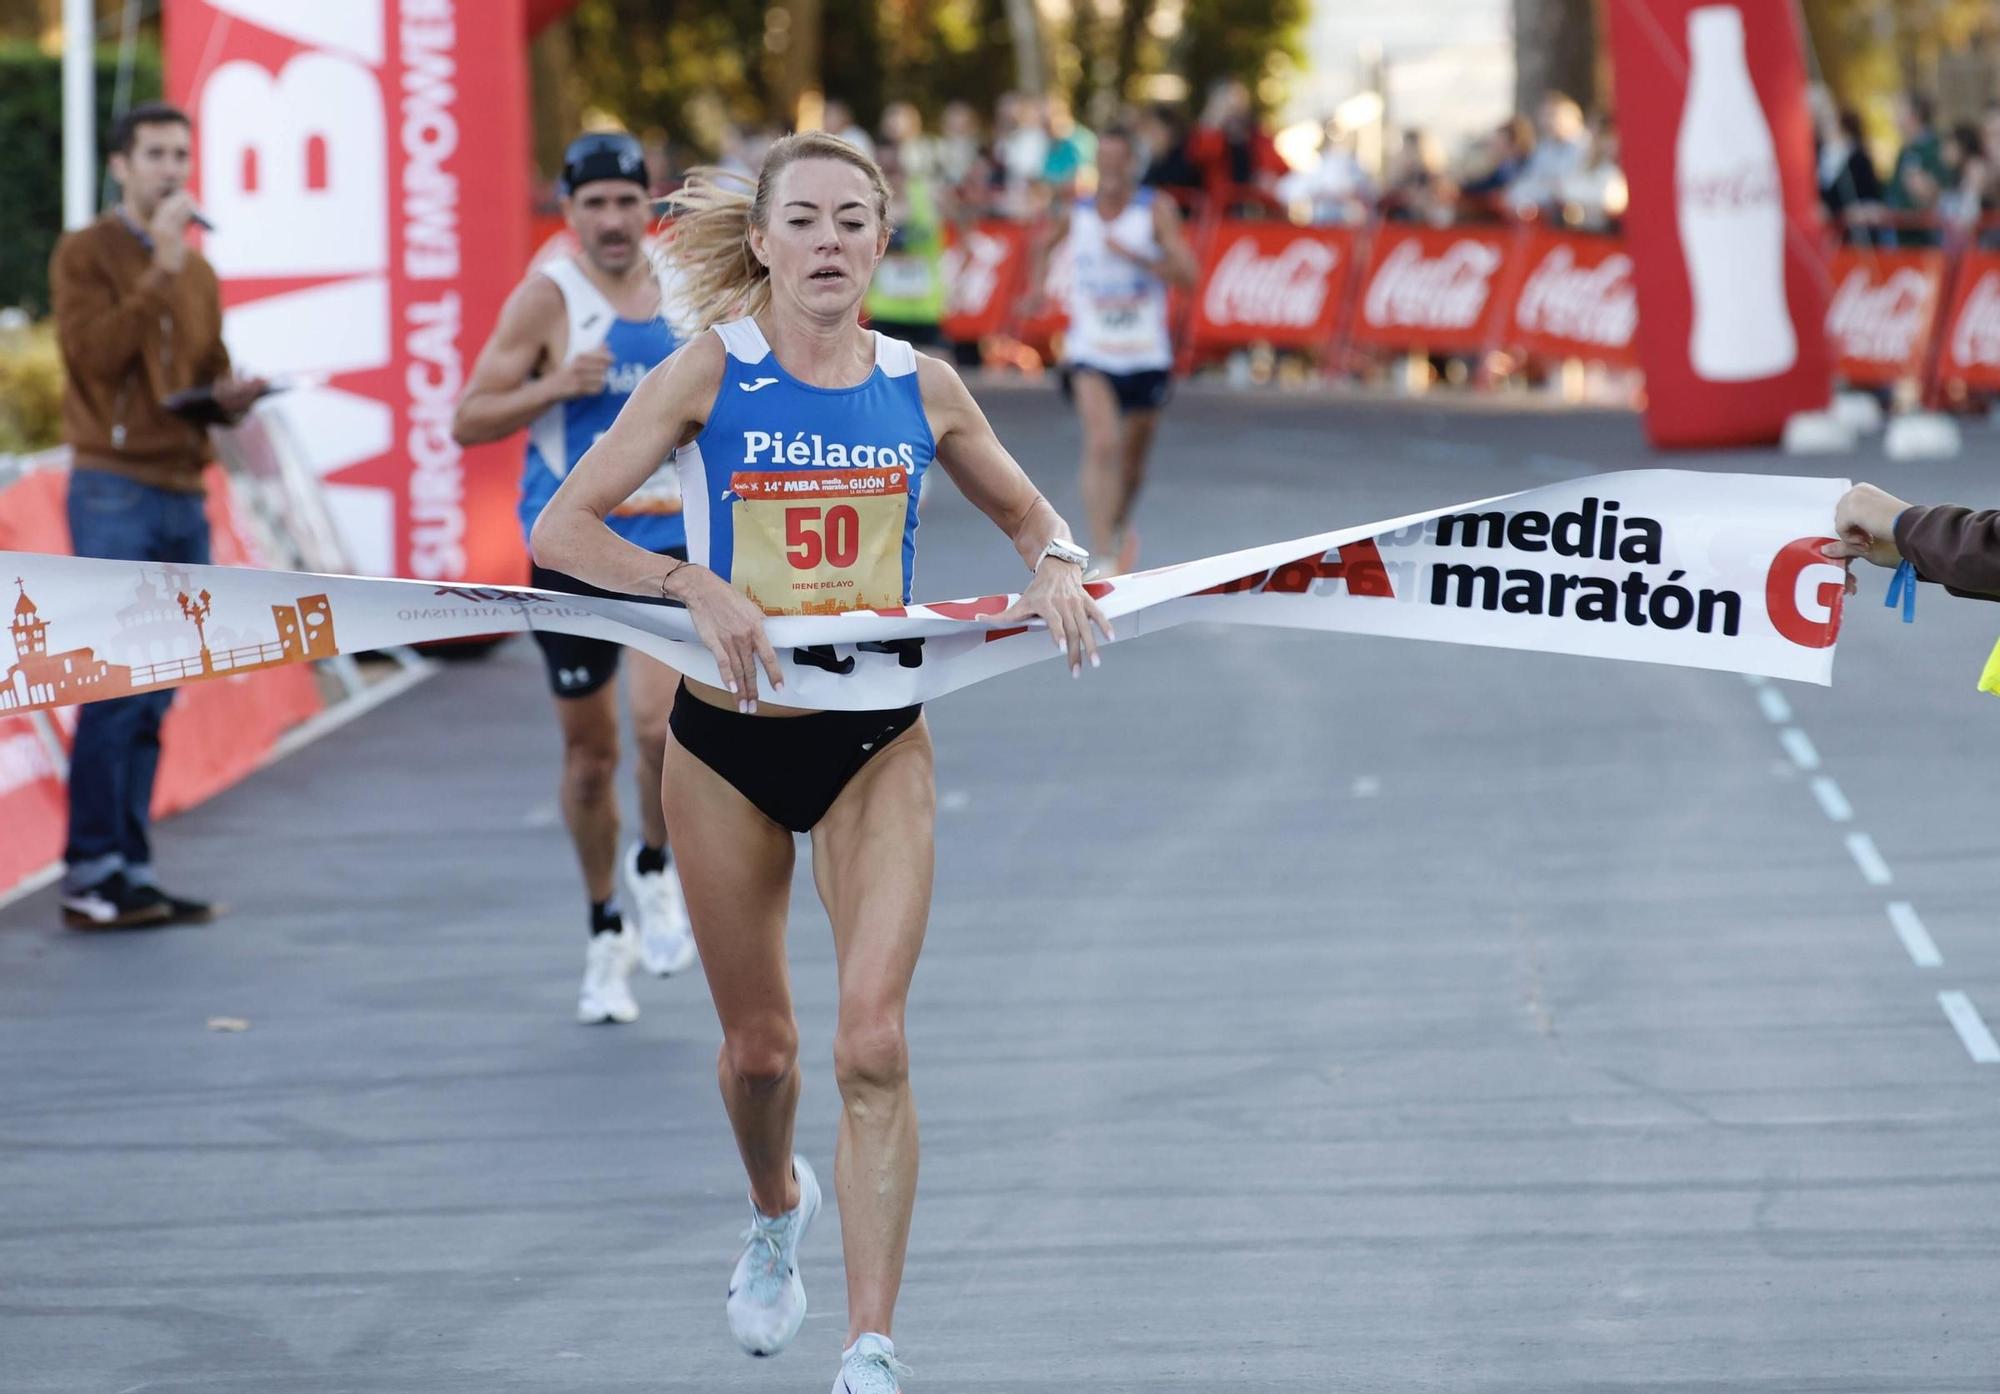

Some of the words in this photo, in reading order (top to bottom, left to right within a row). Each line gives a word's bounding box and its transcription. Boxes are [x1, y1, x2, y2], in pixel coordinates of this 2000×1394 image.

[406, 289, 467, 579] SURGICAL
[743, 431, 915, 475] Piélagos
[784, 480, 820, 491] MBA
[849, 476, 885, 489] GIJÓN
[785, 504, 859, 570] 50
[1434, 497, 1663, 564] media
[792, 582, 819, 590] IRENE
[820, 580, 854, 589] PELAYO
[1430, 569, 1742, 637] maratón
